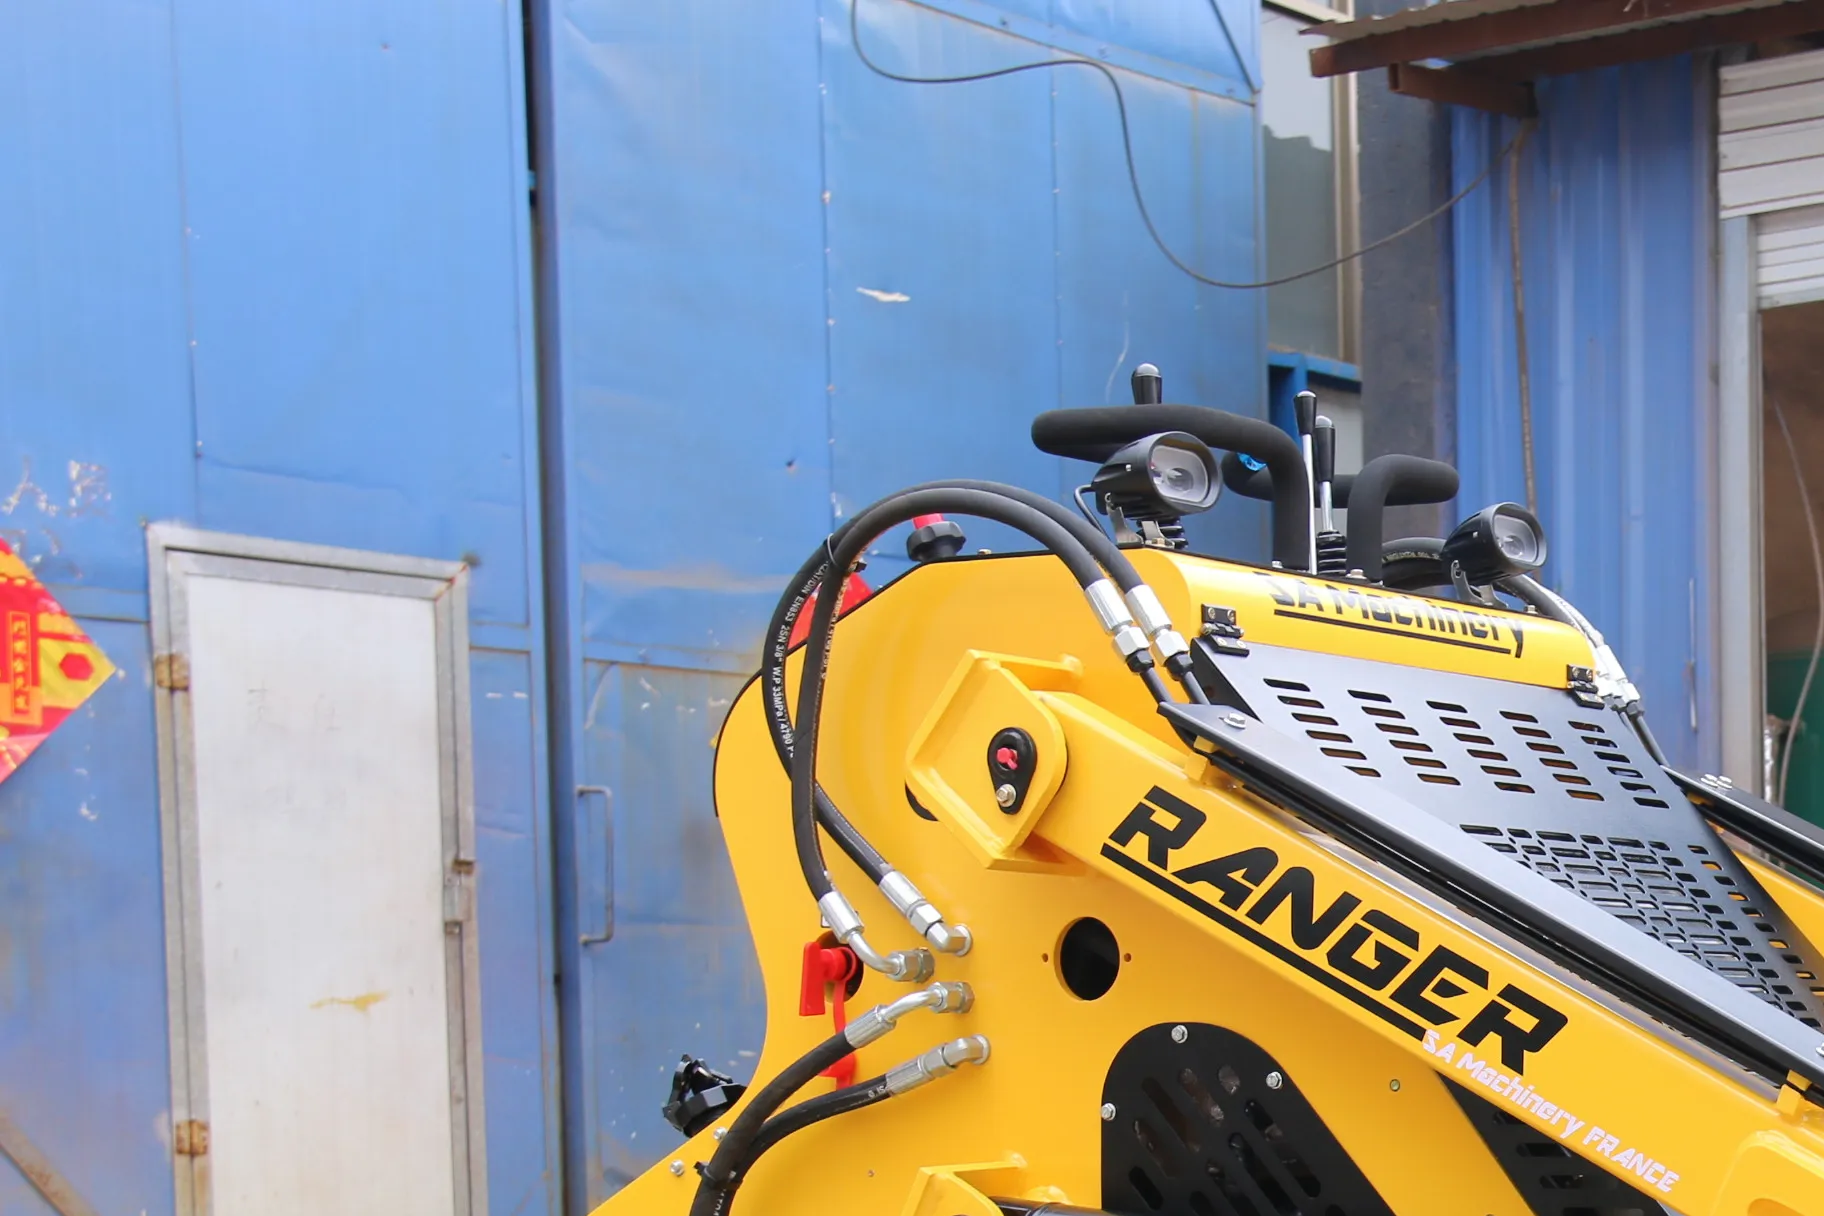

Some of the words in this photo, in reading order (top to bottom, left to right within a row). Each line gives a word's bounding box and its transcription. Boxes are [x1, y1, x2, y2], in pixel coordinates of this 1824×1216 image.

[1325, 583, 1524, 660] Machinery
[1108, 784, 1568, 1077] RANGER
[1422, 1028, 1456, 1064] SA
[1456, 1052, 1585, 1139] Machinery
[1582, 1126, 1680, 1193] FRANCE
